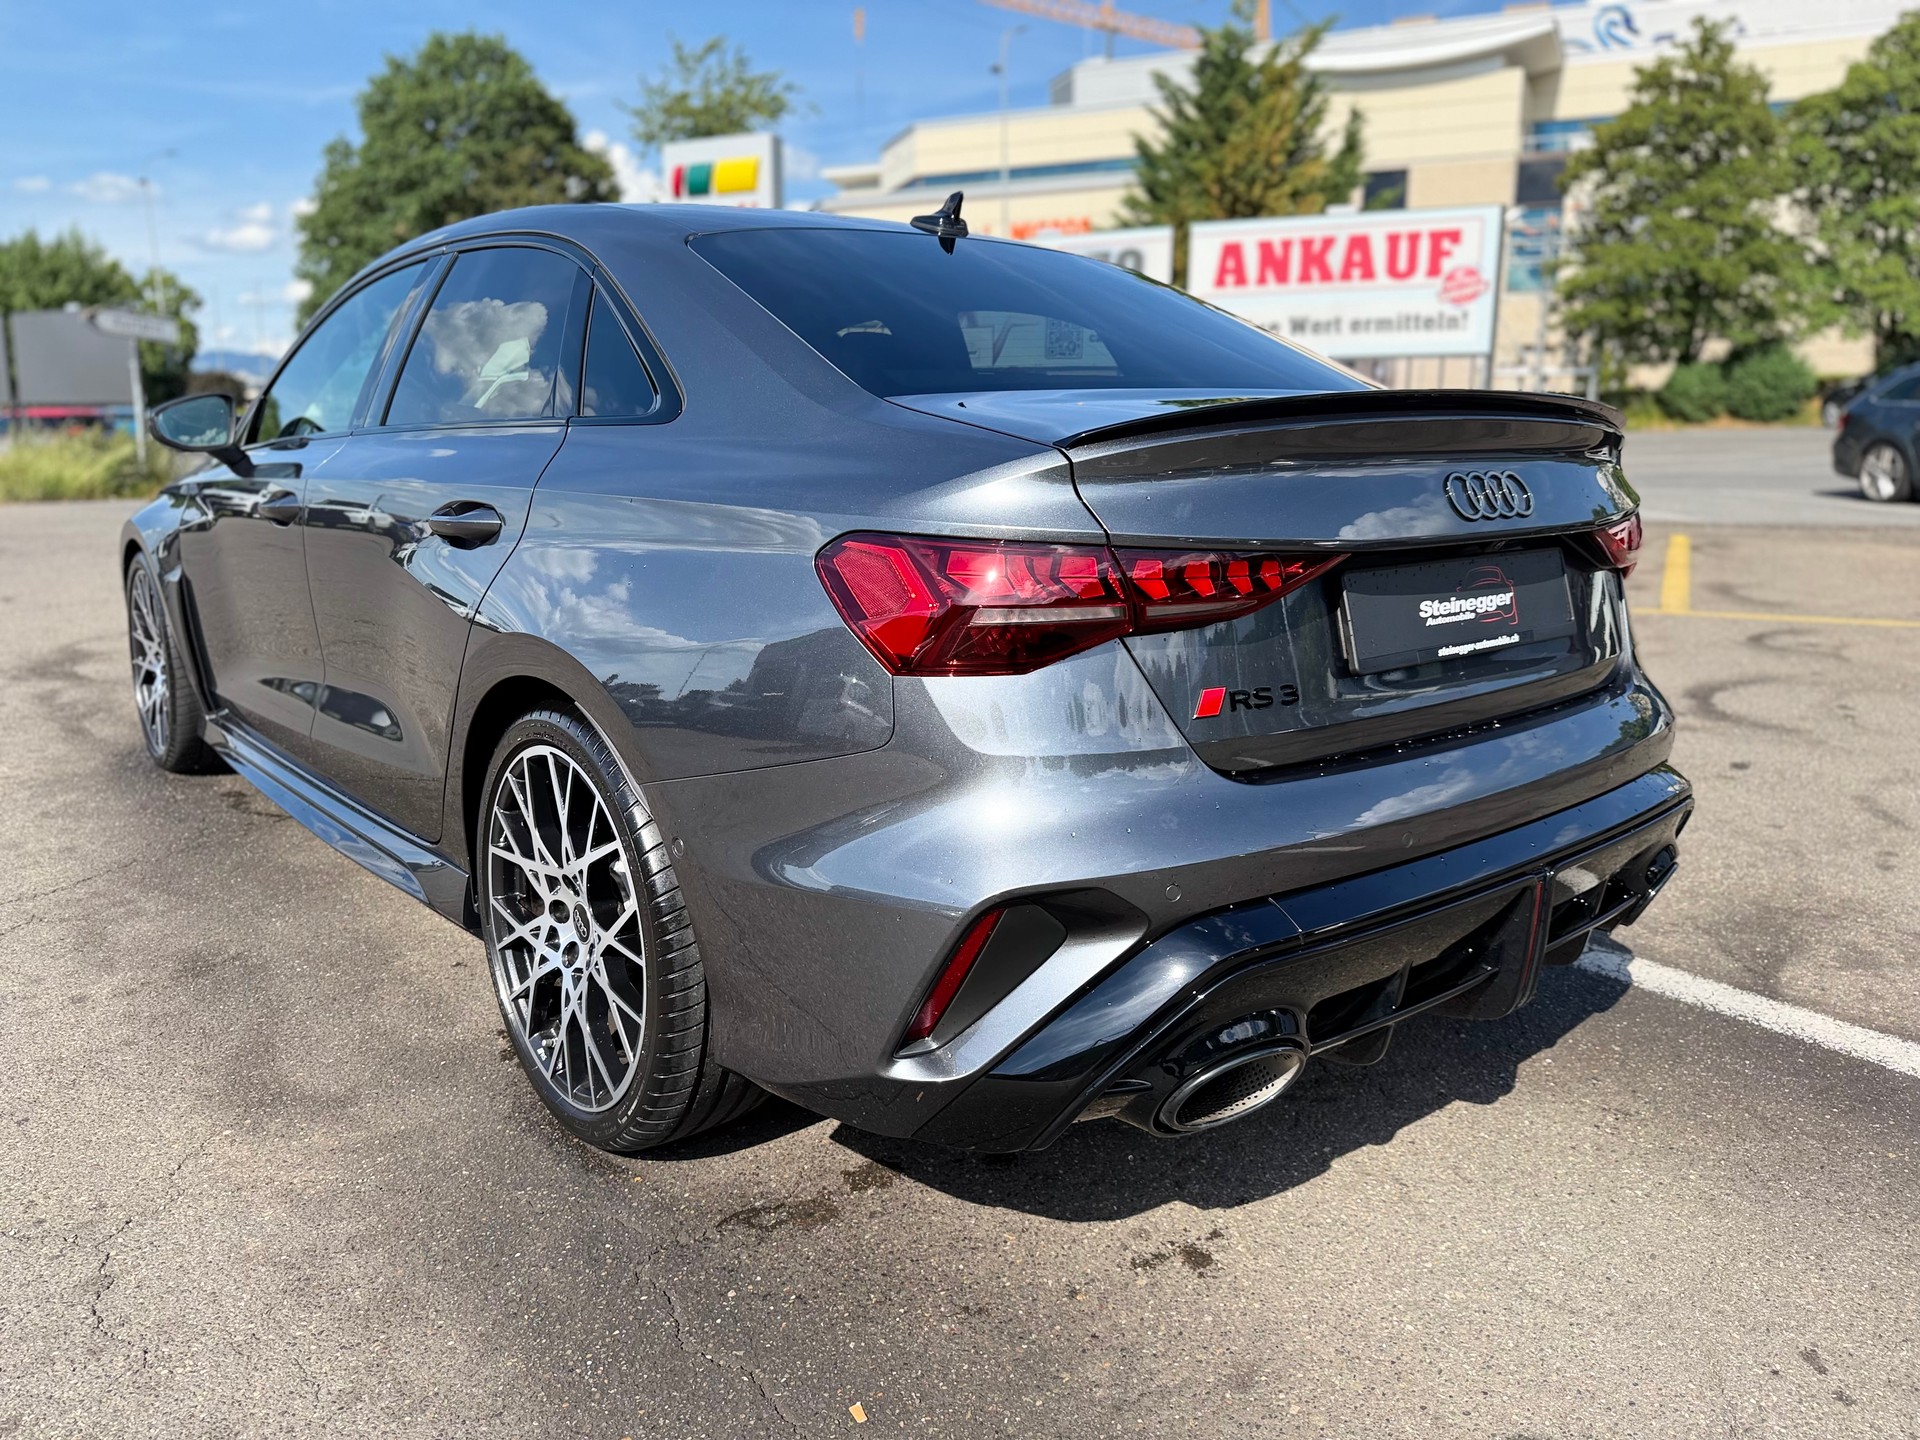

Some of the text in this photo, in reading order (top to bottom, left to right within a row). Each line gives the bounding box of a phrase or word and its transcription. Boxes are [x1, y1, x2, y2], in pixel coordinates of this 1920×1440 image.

[1214, 229, 1462, 287] ANKAUF
[1289, 316, 1342, 336] Wert
[1350, 310, 1469, 333] ermitteln!
[1419, 592, 1514, 618] Steinegger
[1425, 612, 1476, 627] Automobile
[1228, 684, 1300, 712] RS 3
